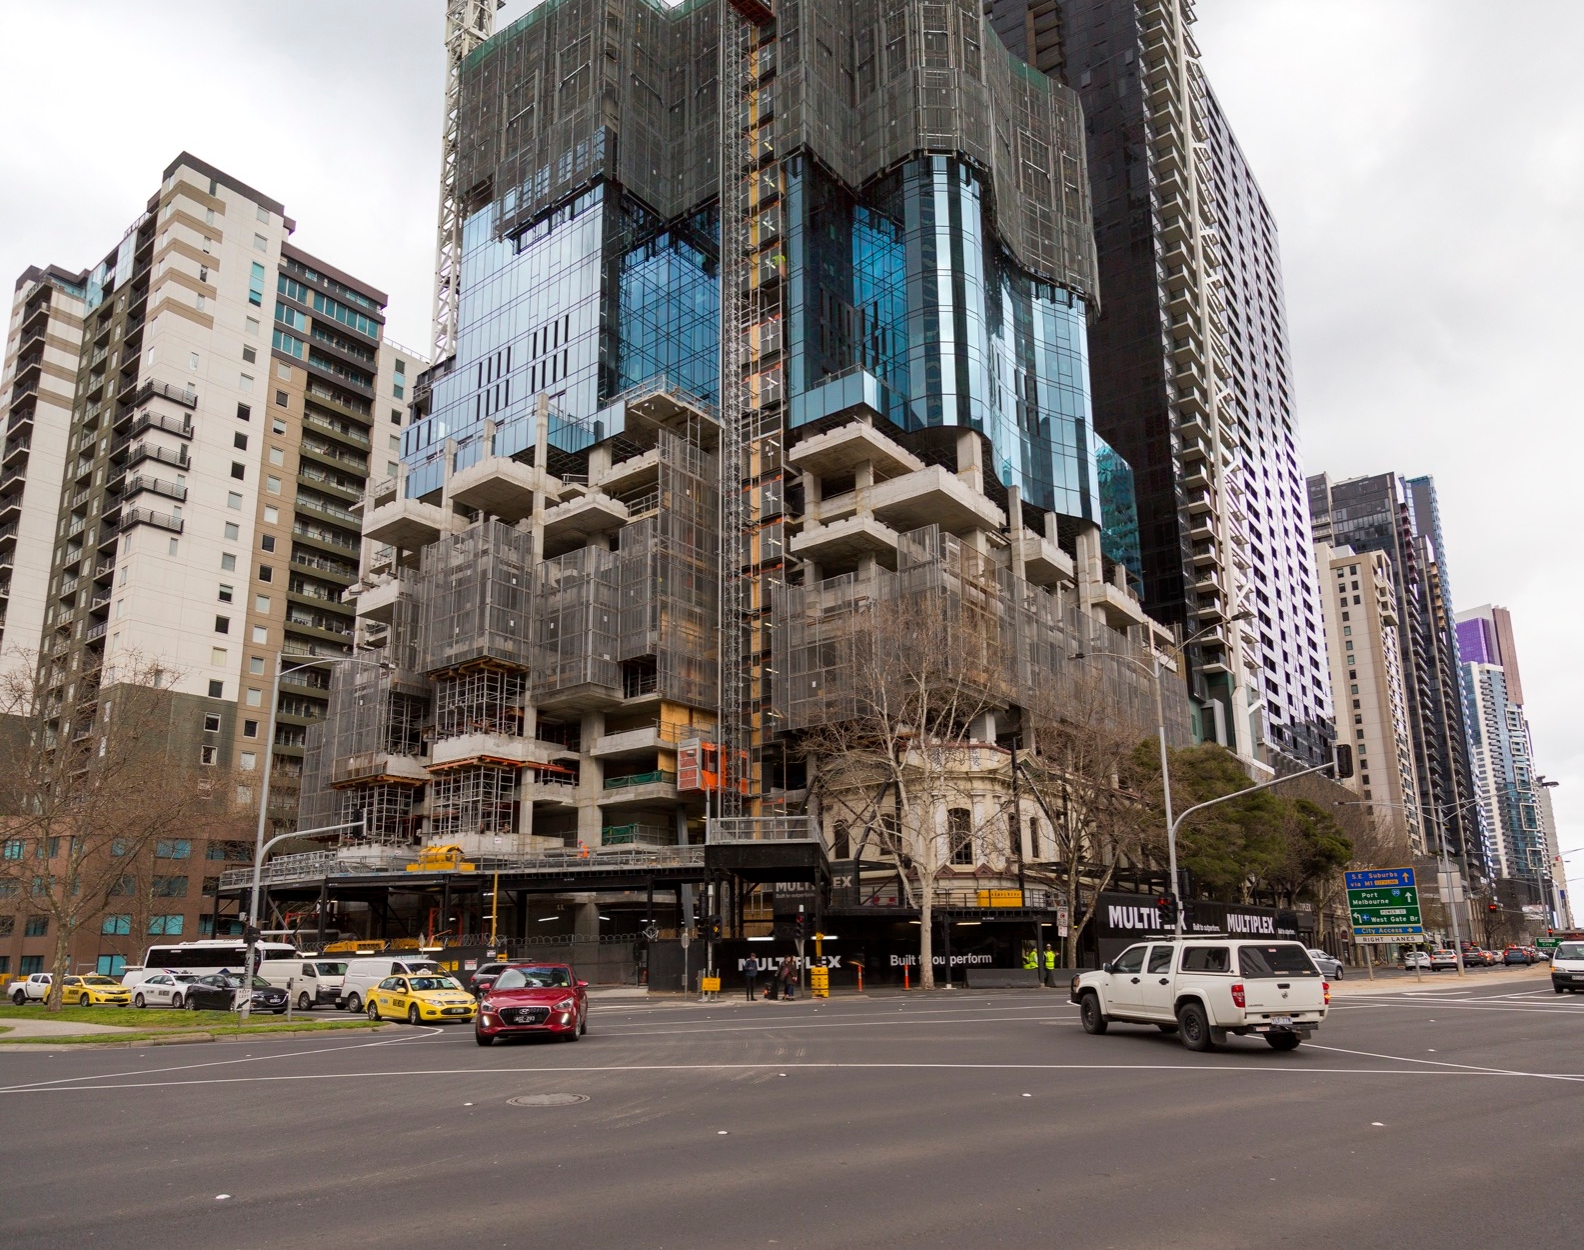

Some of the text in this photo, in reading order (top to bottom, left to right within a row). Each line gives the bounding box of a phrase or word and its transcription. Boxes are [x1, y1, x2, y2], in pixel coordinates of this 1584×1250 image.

[1226, 913, 1275, 934] MULTIPLEX
[890, 954, 916, 966] Built
[932, 953, 992, 967] ouperform
